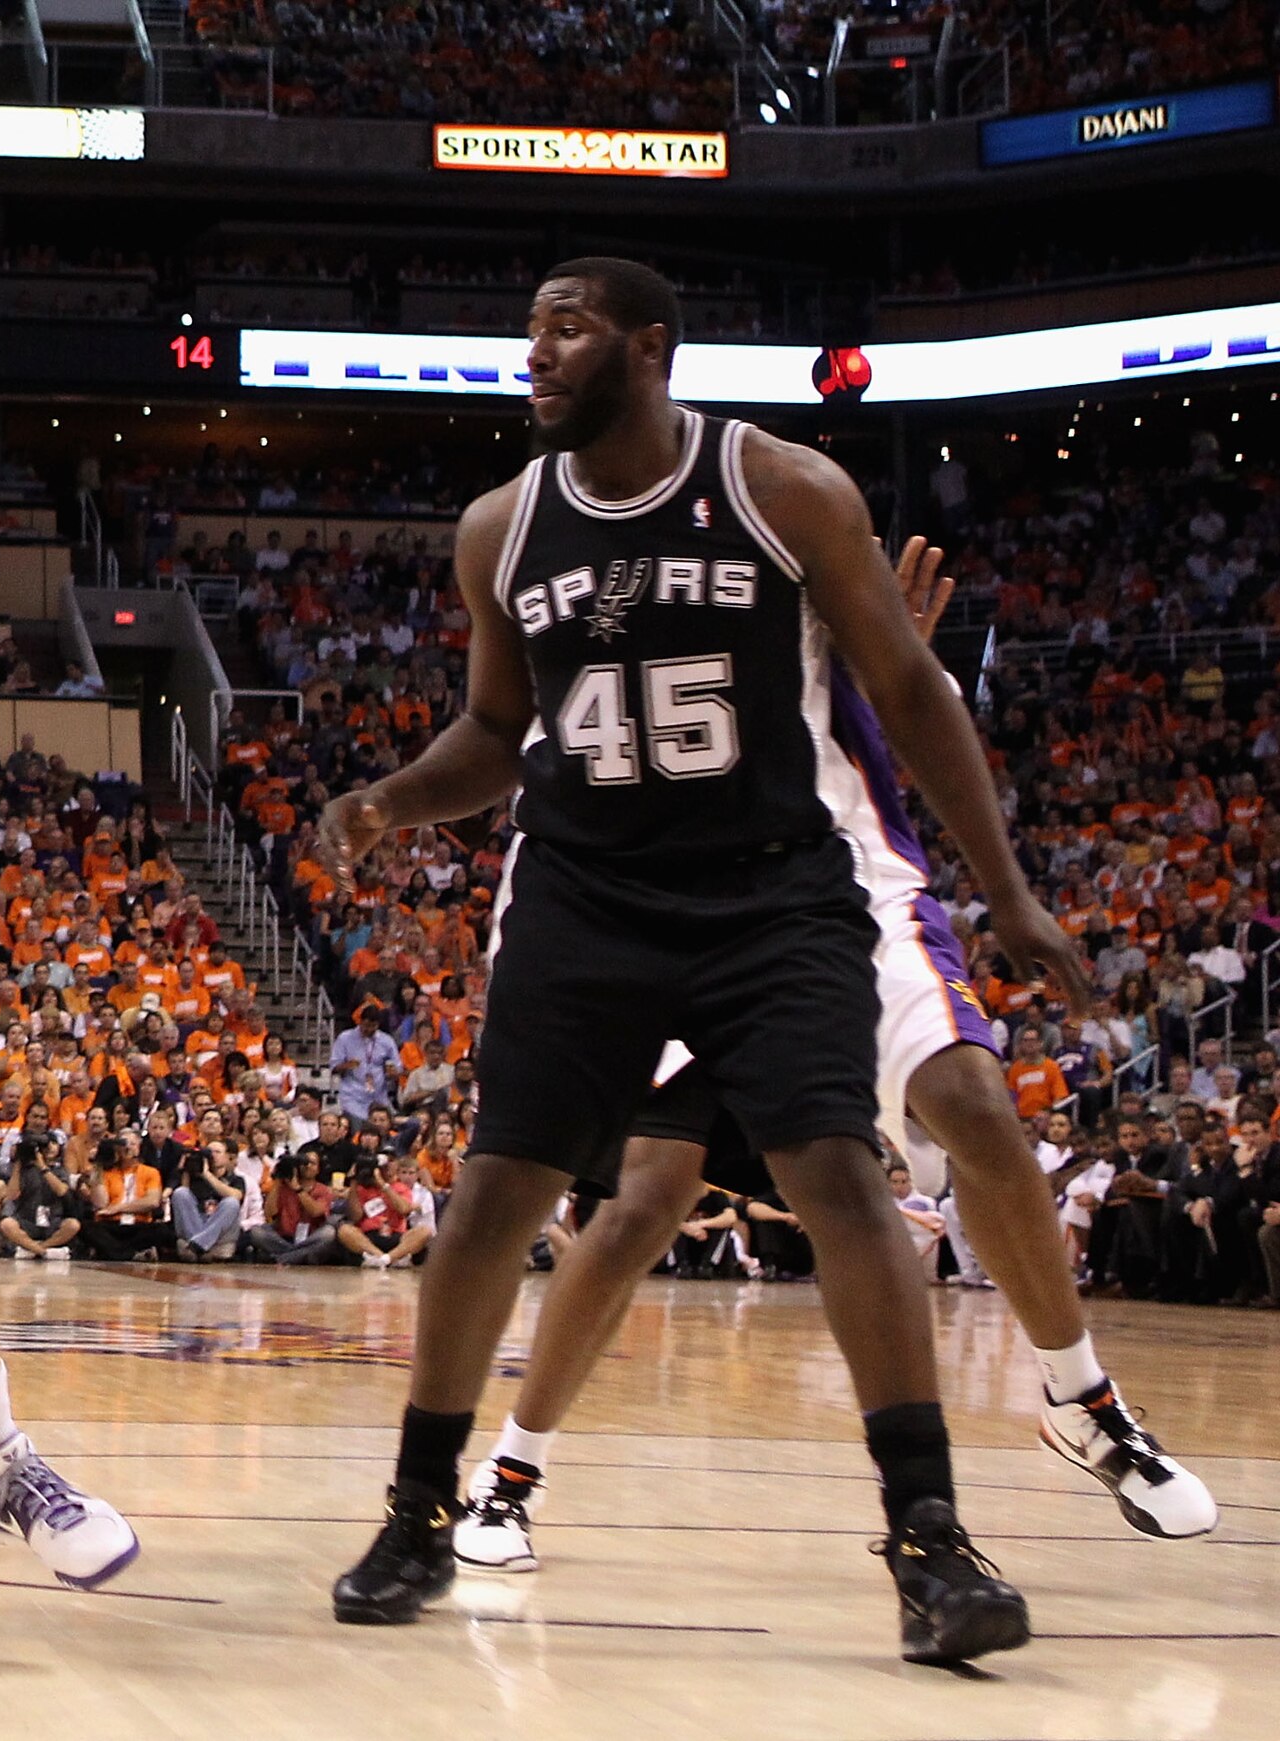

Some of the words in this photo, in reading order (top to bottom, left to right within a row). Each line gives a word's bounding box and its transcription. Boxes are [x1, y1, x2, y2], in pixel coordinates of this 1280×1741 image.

[1083, 105, 1168, 142] DASANI
[442, 136, 560, 160] SPORTS
[564, 131, 636, 169] 620
[641, 141, 719, 164] KTAR
[170, 335, 214, 368] 14
[515, 556, 759, 640] SPURS
[556, 653, 742, 787] 45
